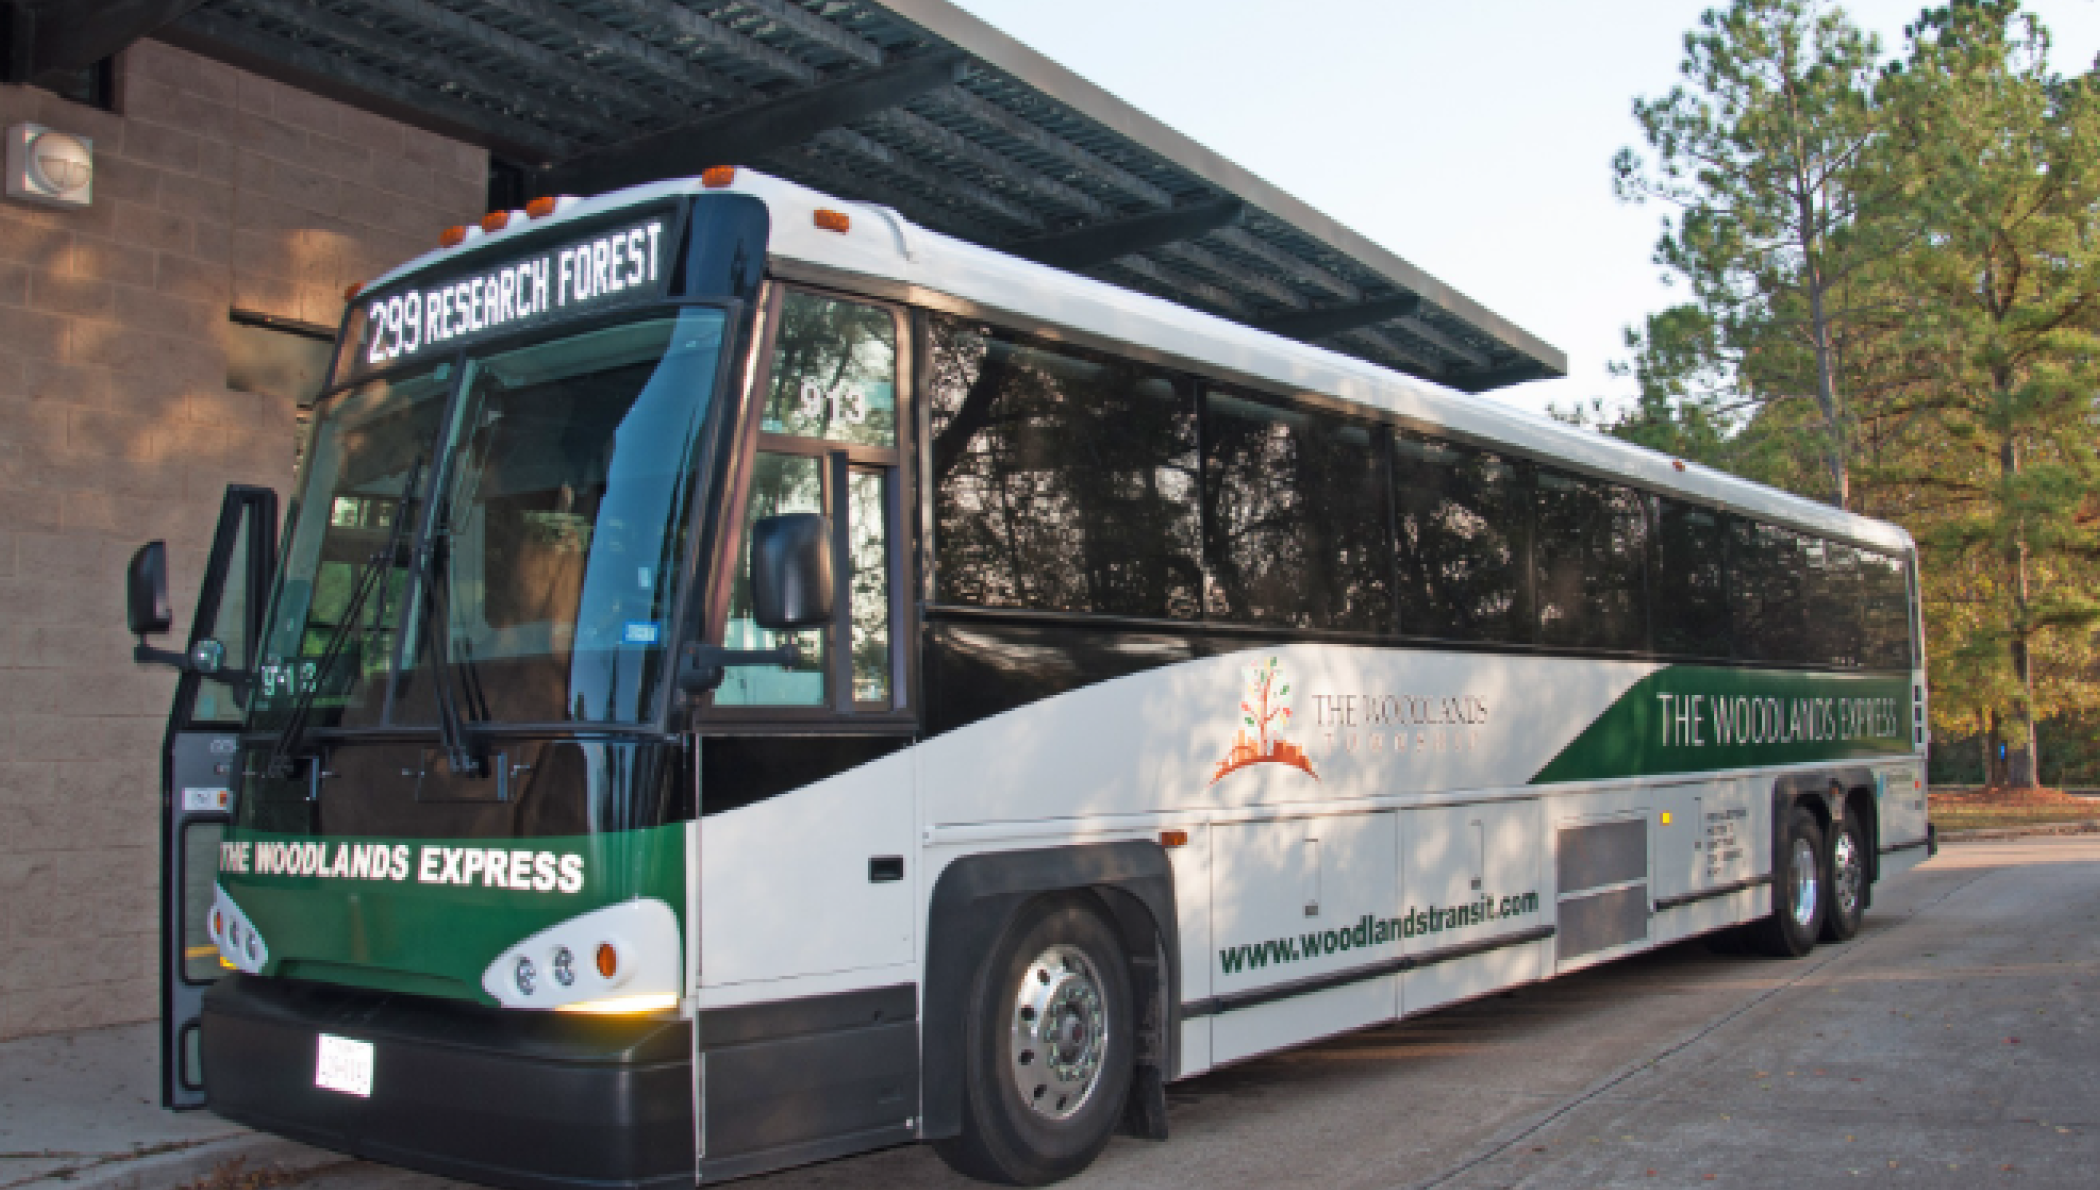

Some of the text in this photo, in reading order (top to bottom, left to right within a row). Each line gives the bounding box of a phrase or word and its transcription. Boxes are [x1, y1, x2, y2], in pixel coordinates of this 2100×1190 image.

[367, 222, 662, 363] 299 RESEARCH FOREST
[802, 377, 866, 424] 913
[1312, 695, 1488, 726] THE WOODLANDS
[1656, 692, 1897, 747] THE WOODLANDS EXPRESS
[219, 842, 585, 893] THE WOODLANDS EXPRESS
[1219, 890, 1539, 975] www.woodlandstransit.com
